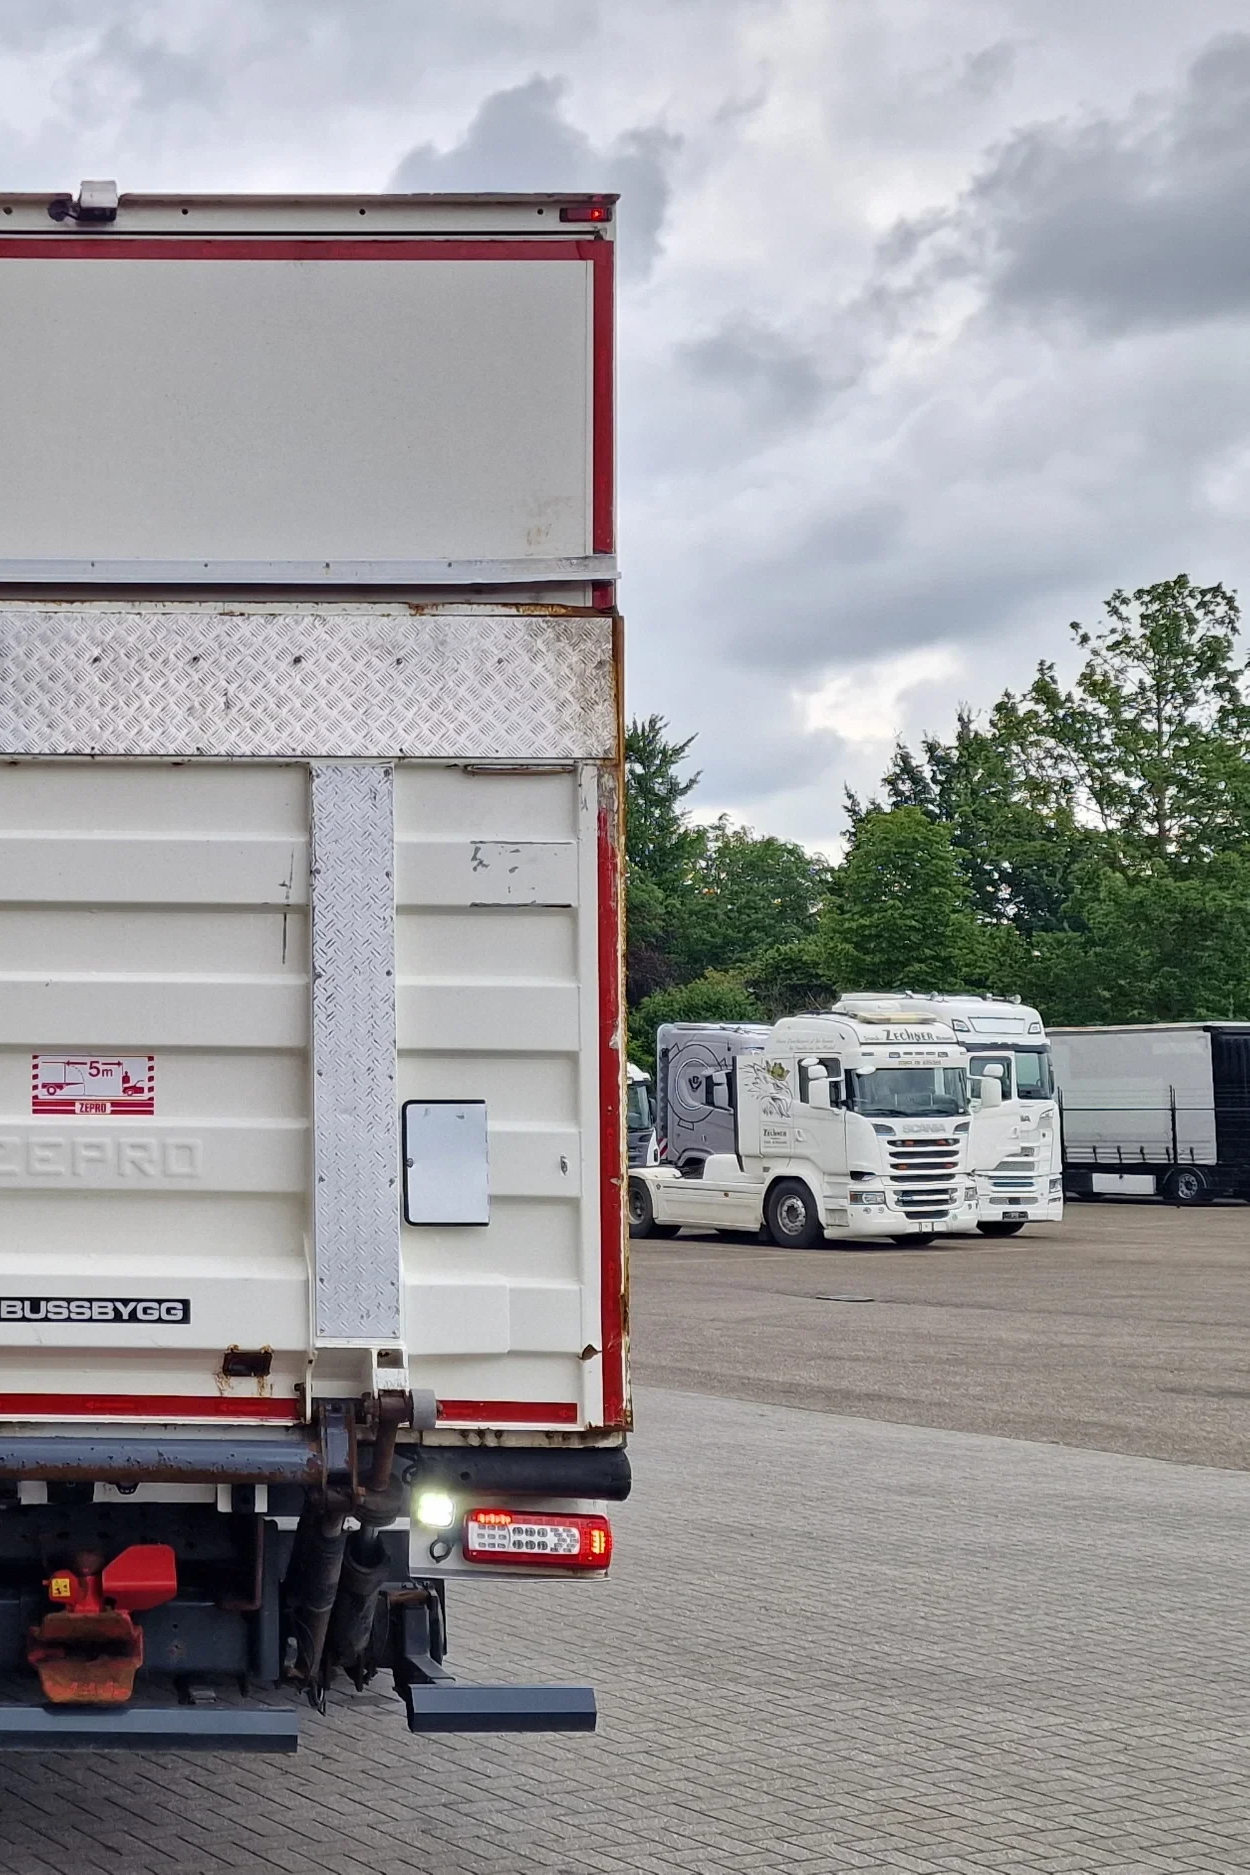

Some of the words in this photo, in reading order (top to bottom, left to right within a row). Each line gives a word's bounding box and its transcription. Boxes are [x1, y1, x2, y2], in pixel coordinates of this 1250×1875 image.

[88, 1061, 113, 1078] 5m
[79, 1102, 107, 1114] ZEPRO
[902, 1124, 946, 1134] SCANIA
[0, 1300, 184, 1321] BUSSBYGG
